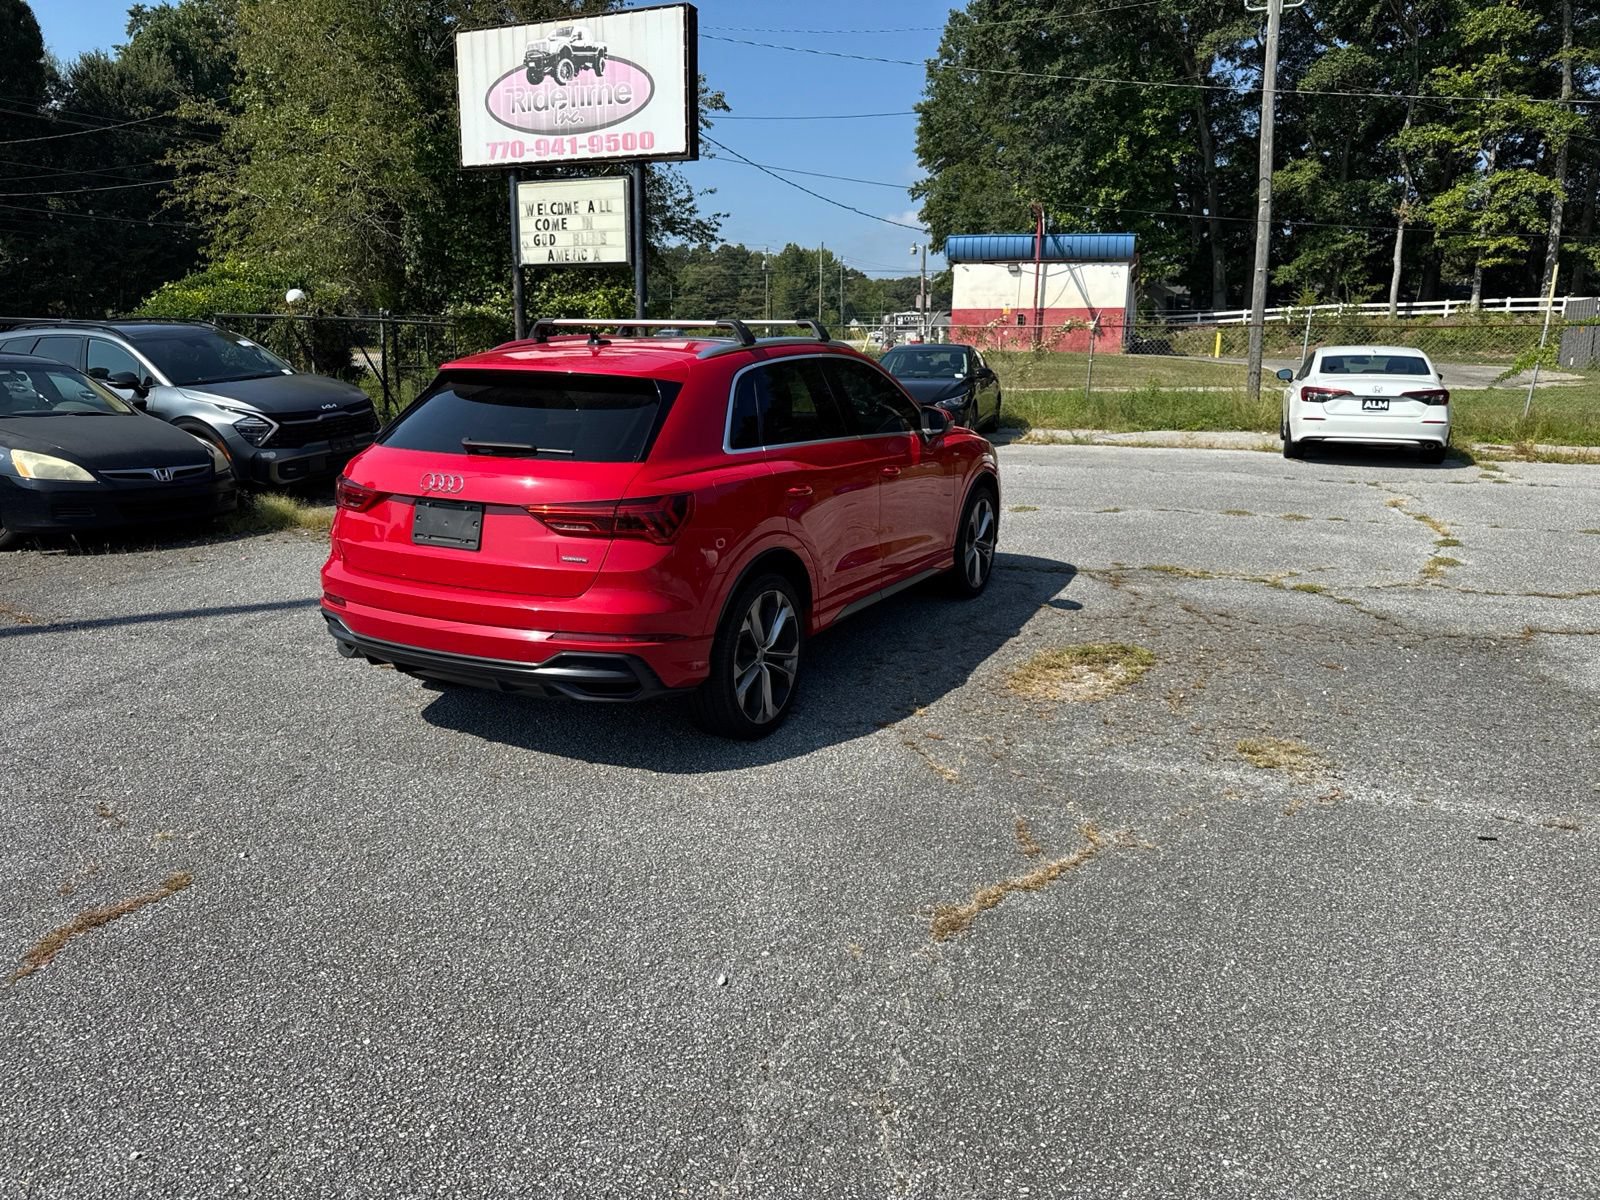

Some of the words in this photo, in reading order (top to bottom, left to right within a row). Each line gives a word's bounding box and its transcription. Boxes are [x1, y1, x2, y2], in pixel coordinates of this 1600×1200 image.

[504, 81, 632, 114] RideTime
[553, 108, 584, 125] Inc.
[486, 131, 655, 160] 770-941-9500
[525, 201, 579, 216] WELCOME
[588, 200, 612, 213] ALL
[535, 217, 567, 231] COME
[534, 233, 556, 247] GOD
[1363, 400, 1388, 409] ALM
